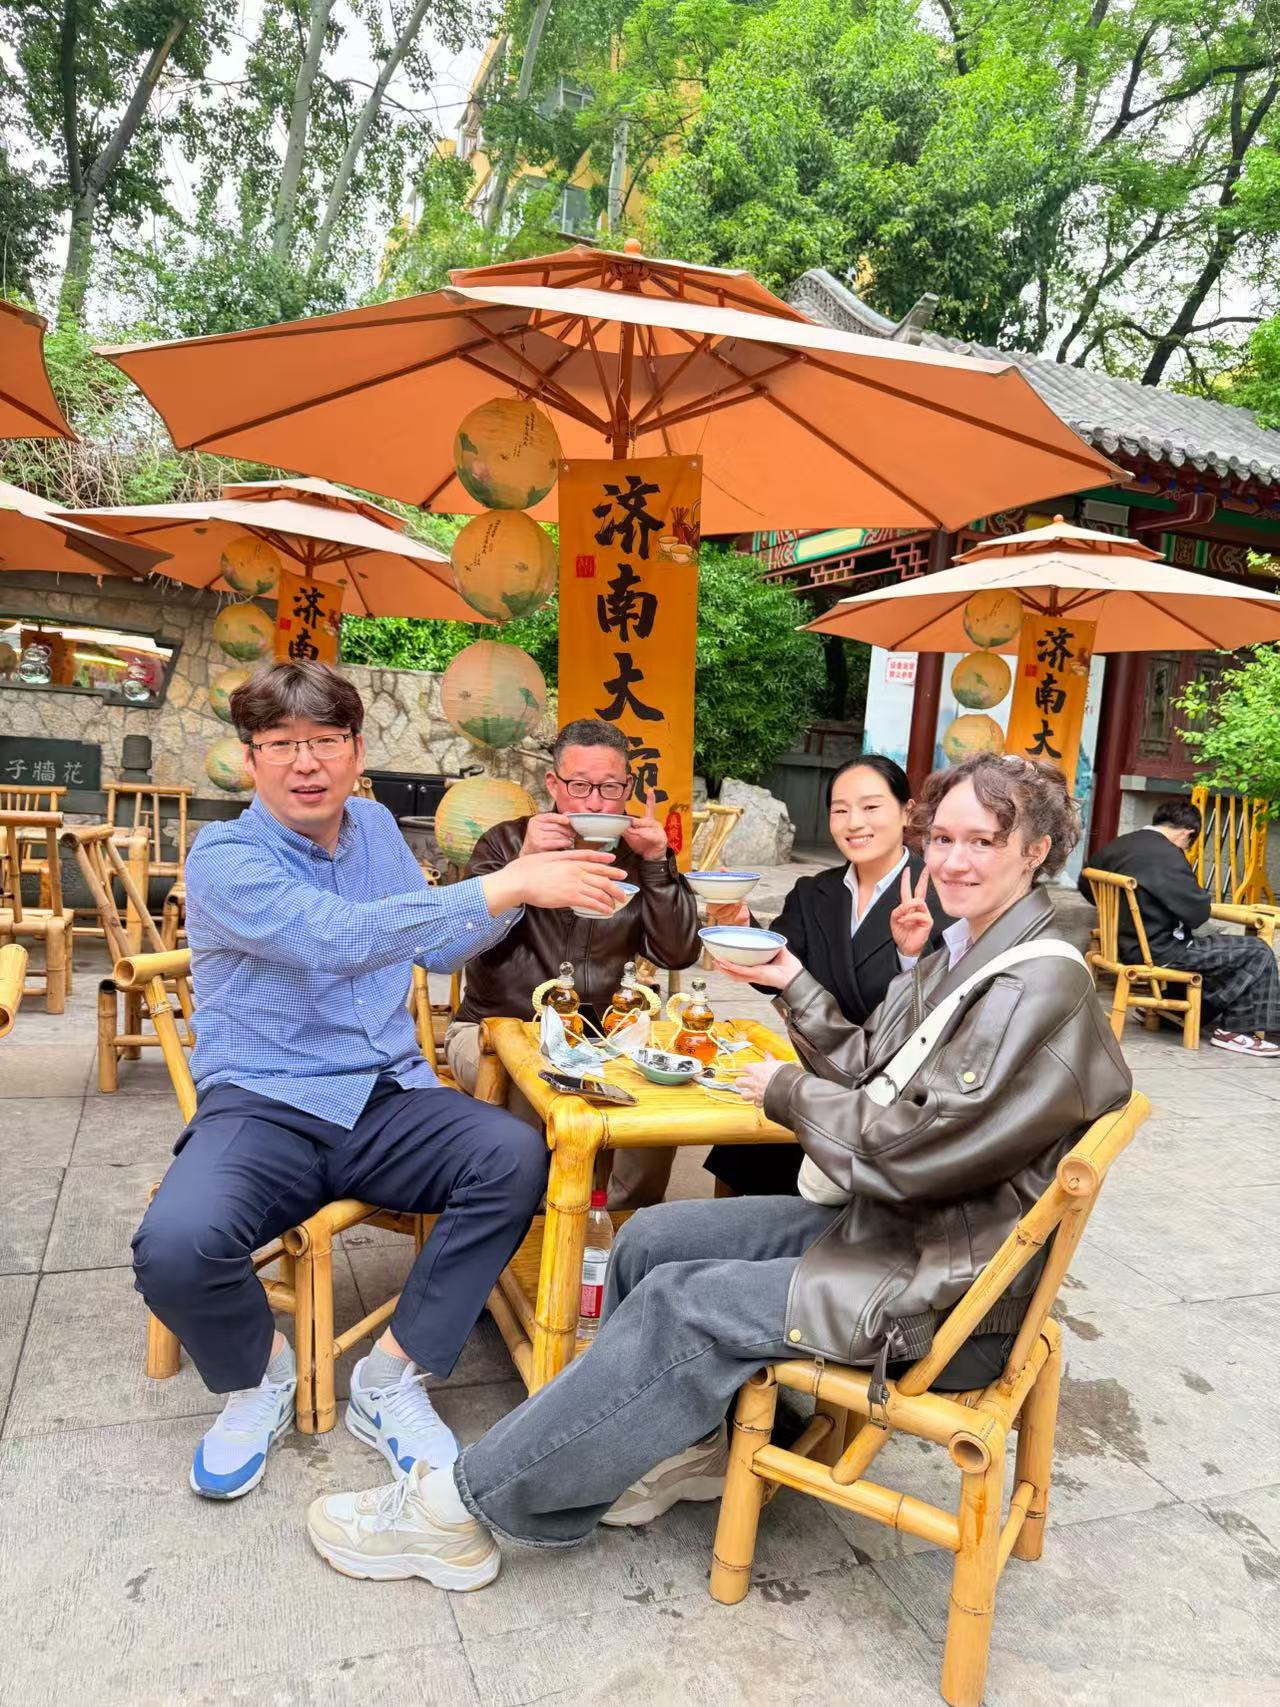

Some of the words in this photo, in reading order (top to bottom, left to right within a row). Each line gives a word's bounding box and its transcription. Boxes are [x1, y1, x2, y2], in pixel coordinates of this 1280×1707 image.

[289, 586, 326, 661] 济南
[1026, 626, 1074, 760] 济南大
